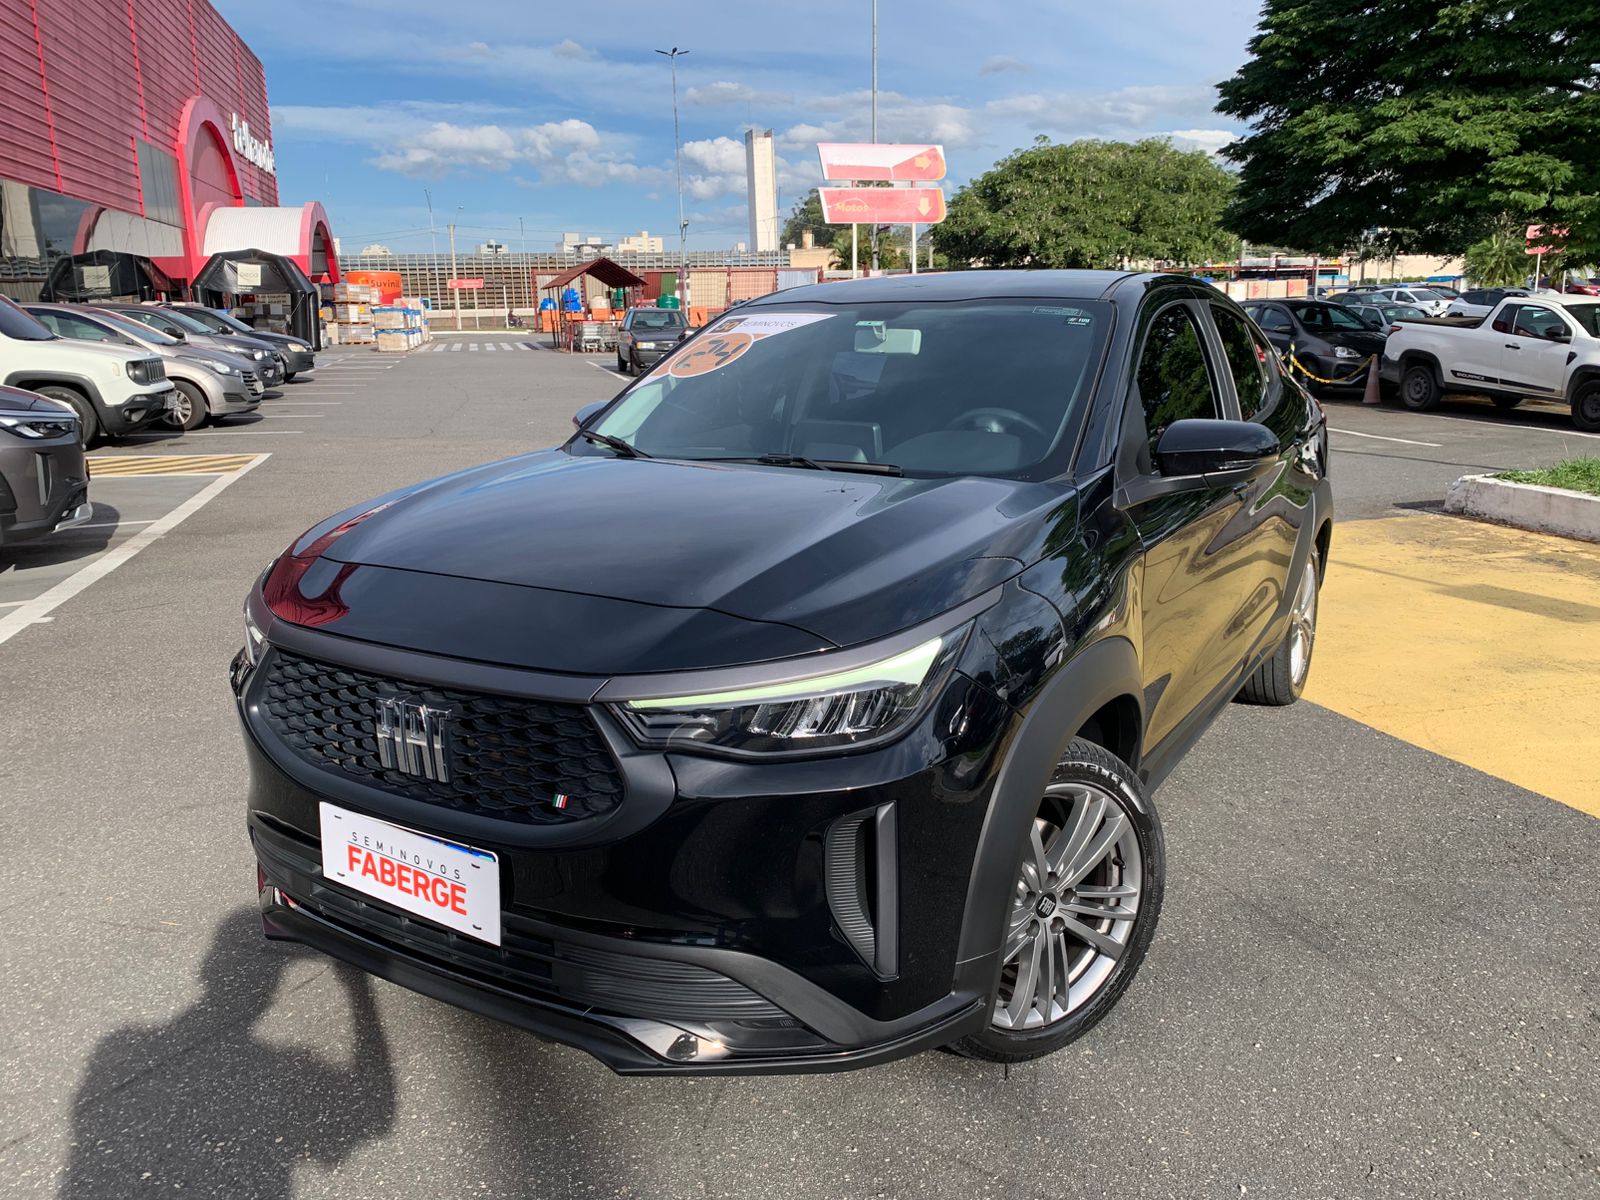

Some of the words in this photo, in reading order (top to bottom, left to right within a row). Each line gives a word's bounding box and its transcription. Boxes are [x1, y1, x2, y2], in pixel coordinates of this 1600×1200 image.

[370, 279, 400, 288] Suvinil
[376, 696, 450, 783] FIAT
[347, 844, 467, 916] FABERGE
[352, 831, 461, 880] SEMINOVOS
[1038, 896, 1056, 916] FIAT
